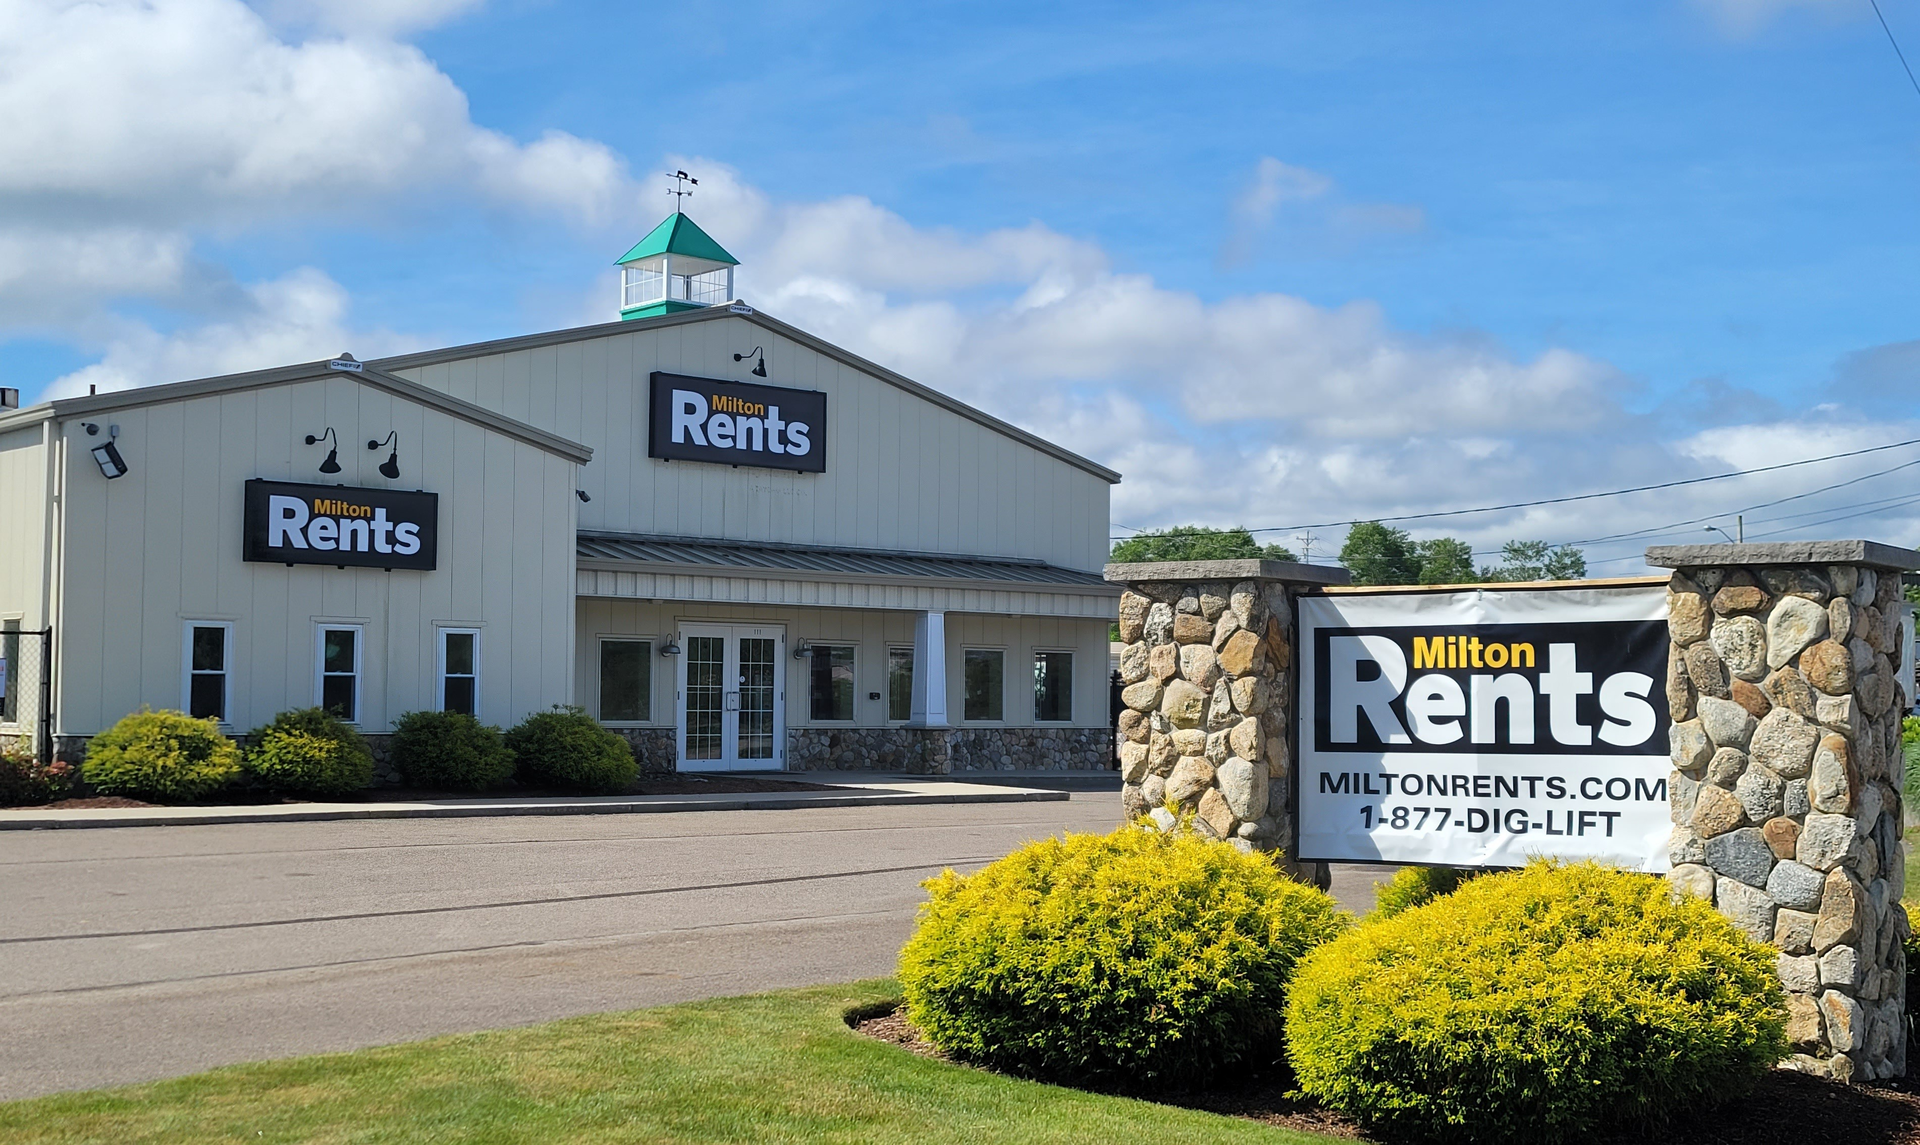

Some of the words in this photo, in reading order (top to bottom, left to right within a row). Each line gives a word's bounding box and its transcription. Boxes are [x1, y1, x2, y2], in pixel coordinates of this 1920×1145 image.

[332, 361, 353, 369] CHIEF
[712, 394, 764, 416] Milton
[671, 389, 811, 456] Rents
[268, 494, 421, 555] Rents
[314, 499, 371, 518] Milton
[1413, 636, 1535, 669] Milton
[1329, 635, 1656, 747] Rents
[1319, 772, 1667, 801] MILTONRENTS.COM
[1360, 805, 1621, 837] 1-877-DIG-LIFT
